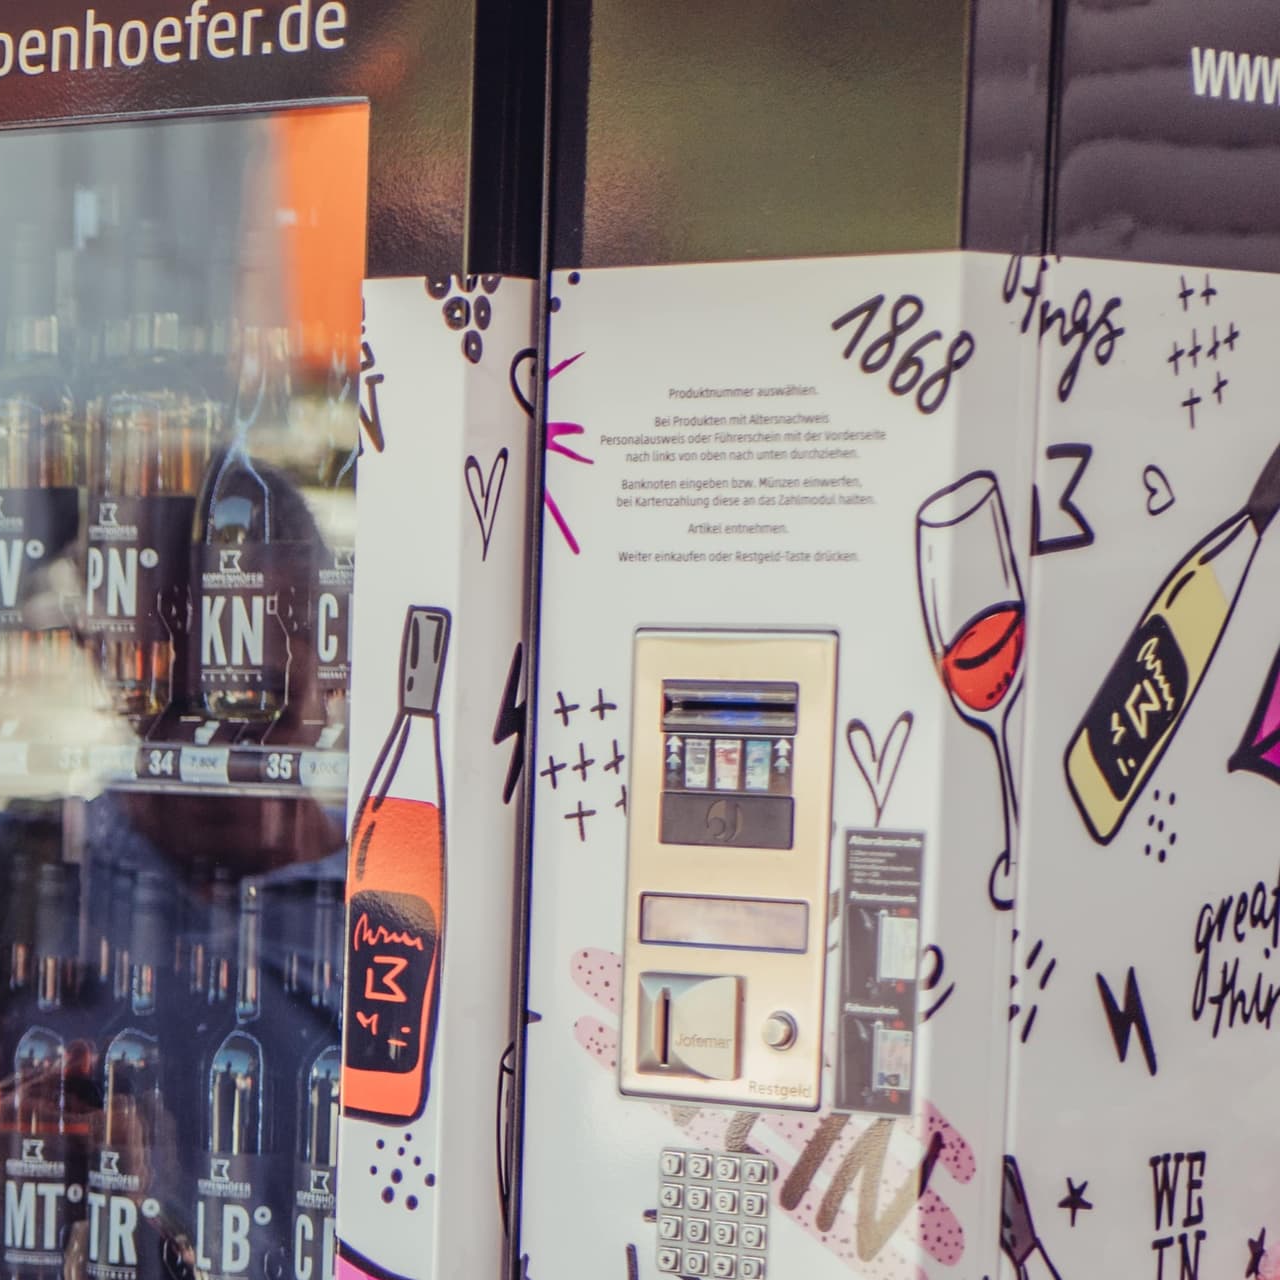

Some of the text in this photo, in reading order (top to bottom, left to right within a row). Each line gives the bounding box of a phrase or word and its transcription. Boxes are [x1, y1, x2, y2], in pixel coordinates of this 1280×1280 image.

[831, 293, 974, 414] 1868
[669, 387, 753, 399] Produktnummer
[655, 413, 829, 427] Bei Produkten mit Altersnachweis
[600, 429, 886, 446] Personalausweis oder Führerschein mit der Vorderseite
[626, 451, 650, 463] nach
[652, 451, 675, 462] links
[678, 452, 697, 462] von
[700, 450, 726, 461] oben
[729, 449, 753, 461] nach
[756, 449, 788, 461] unten
[621, 479, 677, 490] Banknoten
[680, 478, 729, 491] eingeben
[731, 478, 757, 489] bzw.
[759, 476, 800, 488] Münzen
[616, 496, 632, 507] bei
[635, 495, 709, 509] Kartenzahlung
[712, 495, 740, 507] diese
[742, 497, 756, 506] an
[759, 495, 776, 506] das
[778, 494, 835, 506] Zahlmodul
[688, 523, 722, 534] Artikel
[618, 551, 652, 563] Weiter
[654, 551, 705, 563] einkaufen
[708, 551, 732, 562] oder
[735, 551, 810, 564] Restgeld-Taste
[148, 749, 174, 776] 34
[266, 753, 293, 780] 35
[675, 1033, 732, 1049] Jofemar
[748, 1080, 812, 1099] Restgeld
[1149, 1151, 1206, 1231] WE
